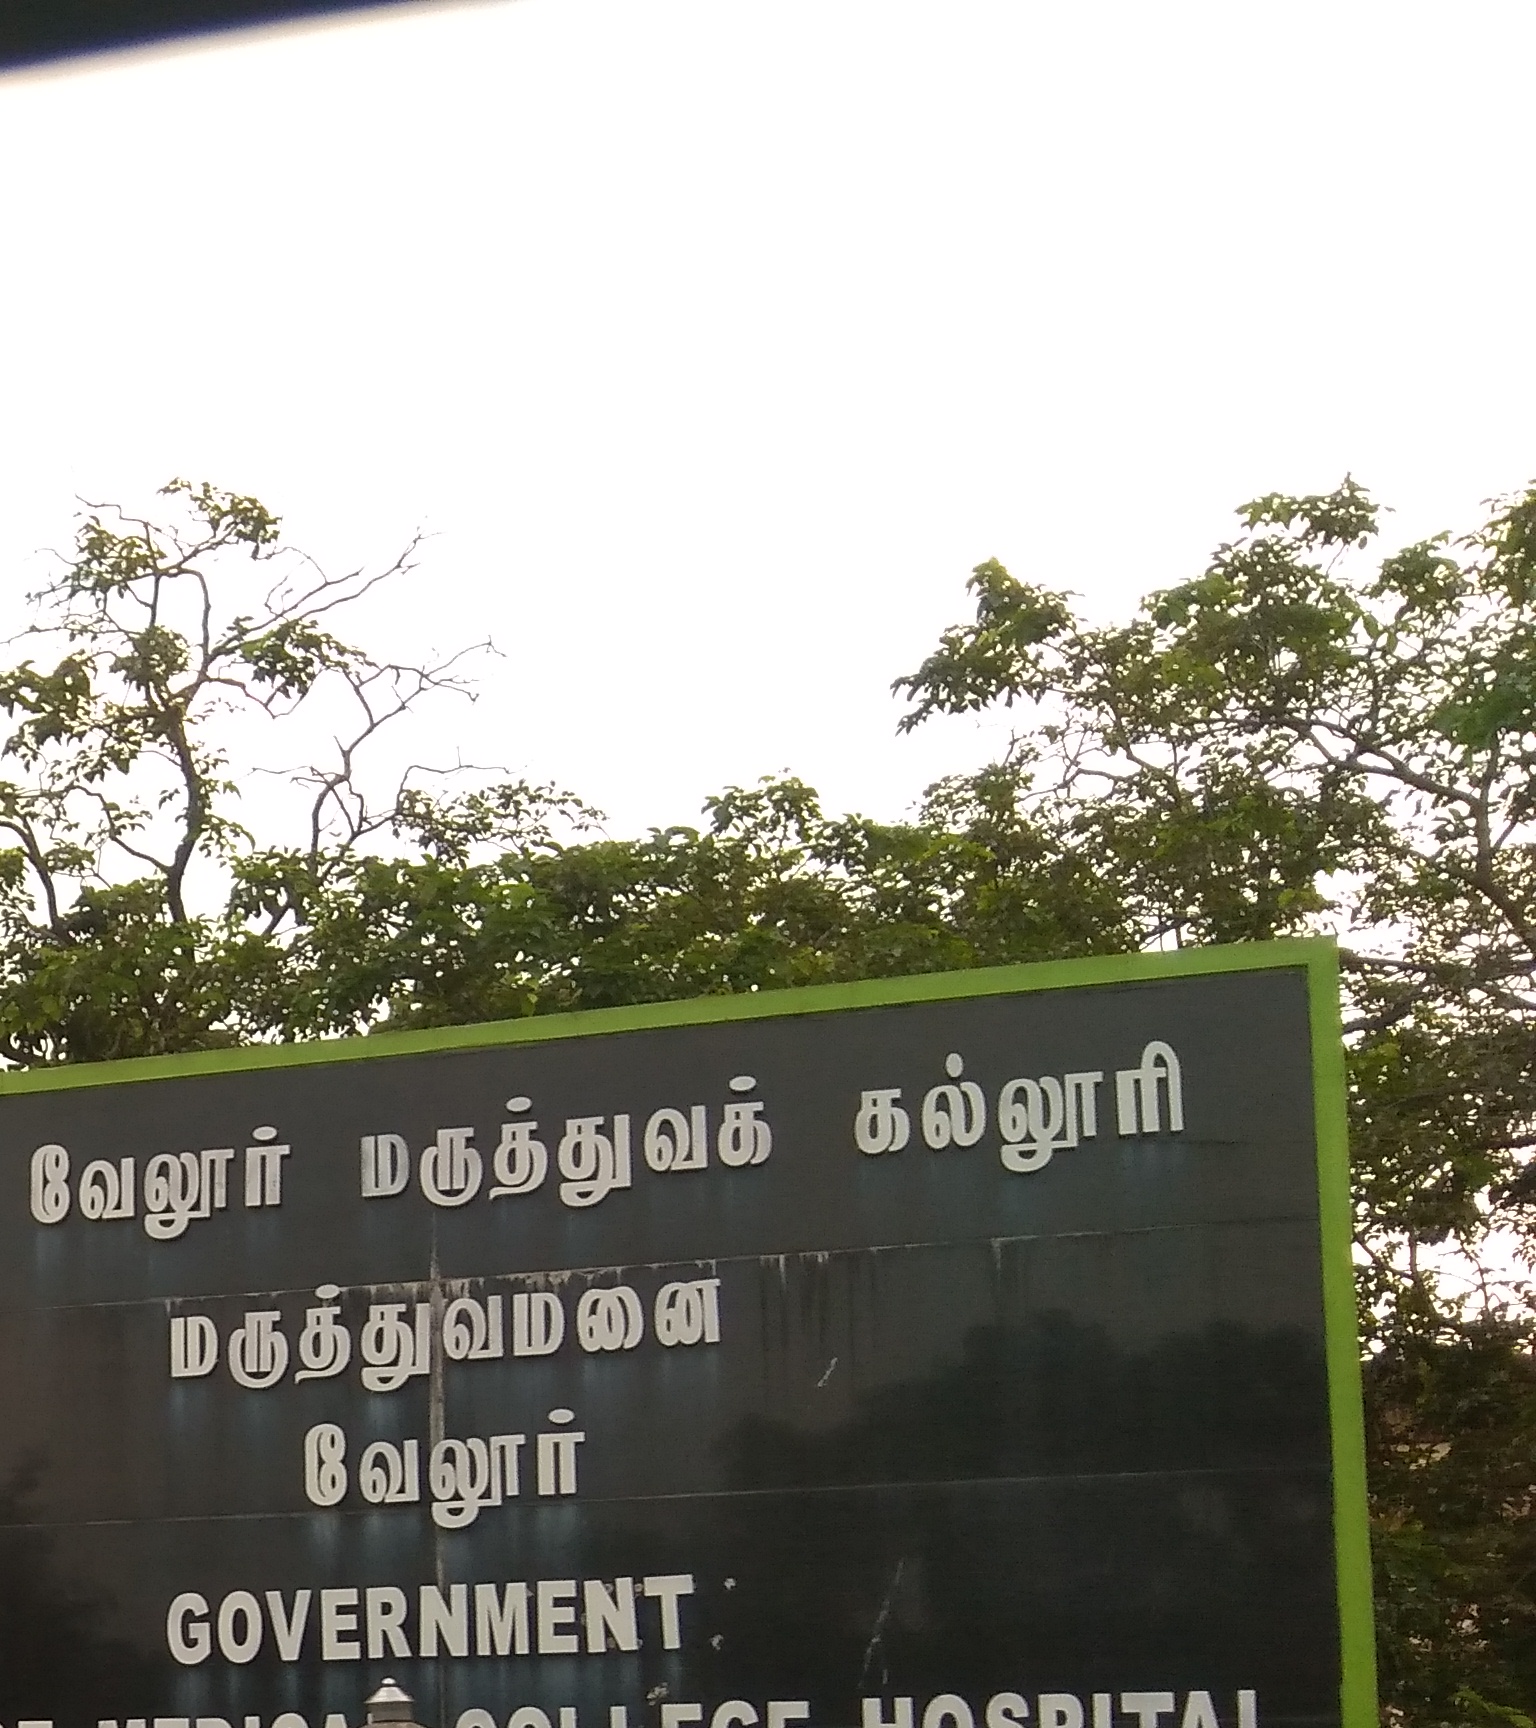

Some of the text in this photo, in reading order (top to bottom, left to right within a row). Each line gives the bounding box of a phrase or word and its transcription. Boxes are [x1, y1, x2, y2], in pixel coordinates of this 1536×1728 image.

[29, 1125, 292, 1240] வேலூர்
[358, 1075, 774, 1208] மருத்துவக்
[853, 1040, 1186, 1173] கல்லூரி
[168, 1278, 722, 1392] மருத்துவமனை
[302, 1408, 586, 1530] வேலூர்
[166, 1573, 696, 1665] GOVERNMENT
